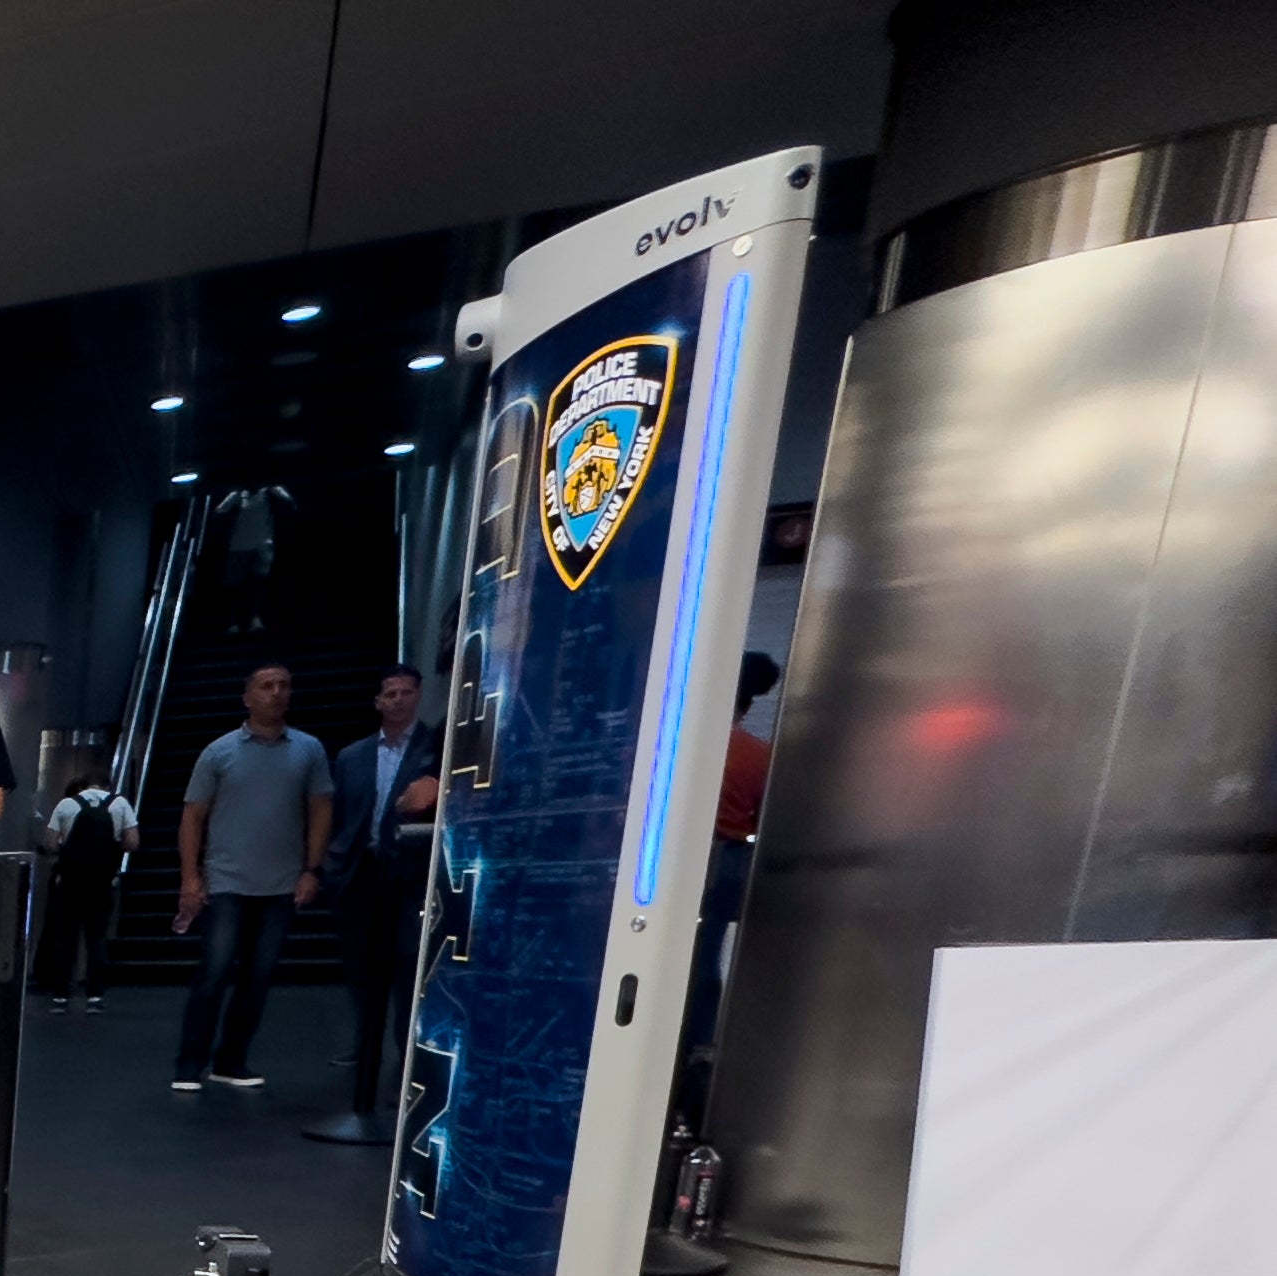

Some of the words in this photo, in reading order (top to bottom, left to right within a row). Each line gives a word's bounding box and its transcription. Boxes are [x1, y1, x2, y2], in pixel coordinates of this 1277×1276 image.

[634, 187, 742, 257] evolv
[571, 352, 638, 401] POLICE
[548, 378, 662, 449] DEPARTMENT
[544, 470, 559, 518] CITY
[552, 526, 570, 551] OF
[587, 495, 624, 550] NEW
[618, 425, 654, 489] YORK
